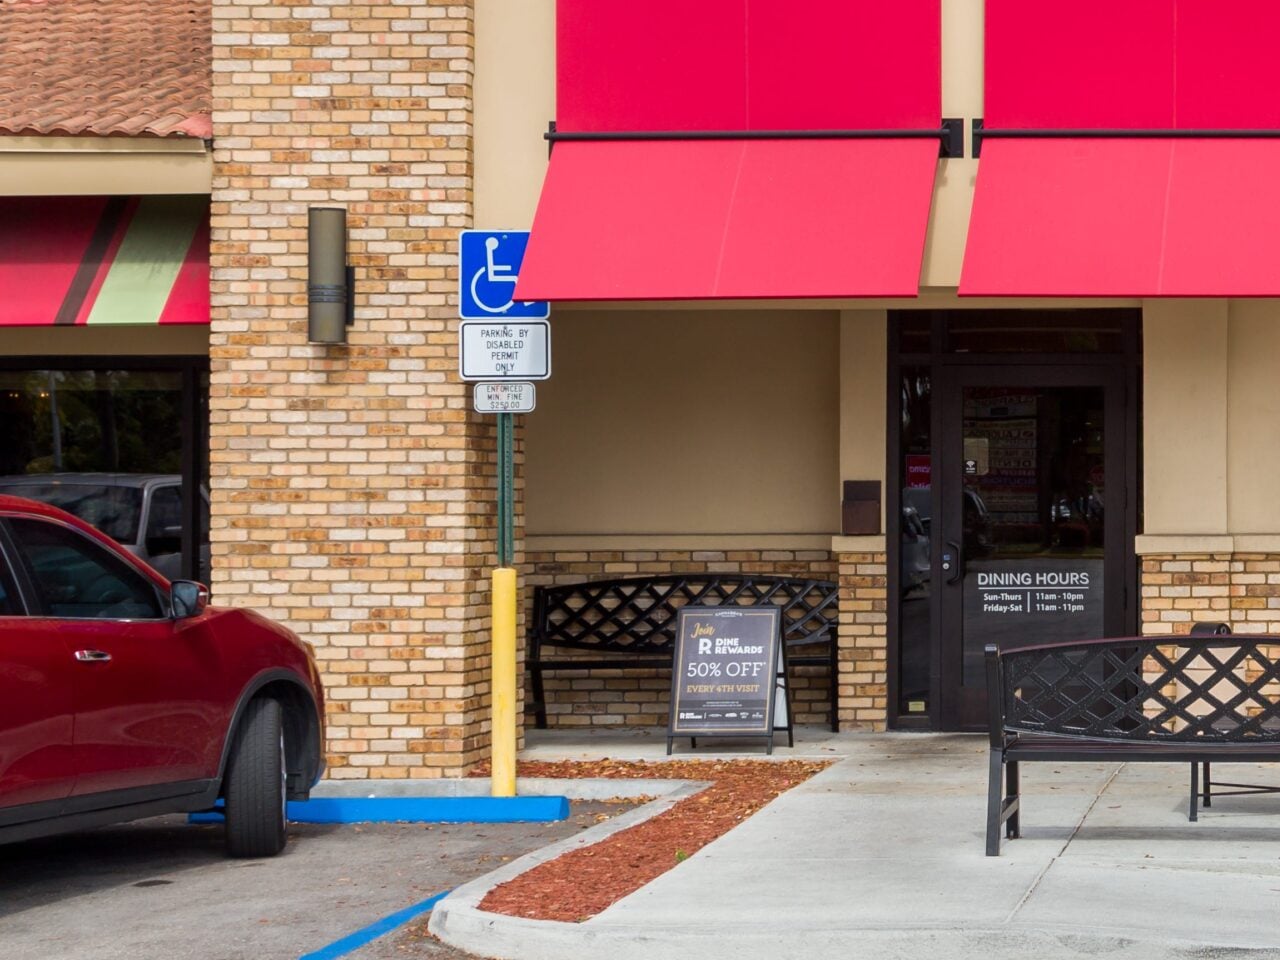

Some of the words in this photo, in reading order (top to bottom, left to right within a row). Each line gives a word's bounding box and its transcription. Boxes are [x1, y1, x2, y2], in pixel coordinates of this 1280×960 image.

[481, 329, 513, 338] PARKING
[519, 329, 529, 338] BY
[486, 340, 524, 349] DISABLED
[491, 351, 519, 360] PERMIT
[495, 363, 515, 372] ONLY
[490, 401, 520, 409] $250.00
[977, 573, 1032, 585] DINING
[1036, 572, 1089, 585] HOURS
[983, 592, 1022, 601] Sun-Thurs
[1035, 592, 1056, 600] 11am
[1063, 592, 1084, 601] 10pm
[983, 604, 1022, 613] Friday-Sat
[1063, 603, 1084, 612] 11pm
[690, 622, 715, 638] Join
[715, 637, 739, 646] DINE
[715, 646, 763, 654] REWARDS
[687, 662, 721, 677] 50%
[686, 685, 714, 693] EVERY
[716, 685, 734, 693] 4TH
[736, 684, 760, 692] VISIT
